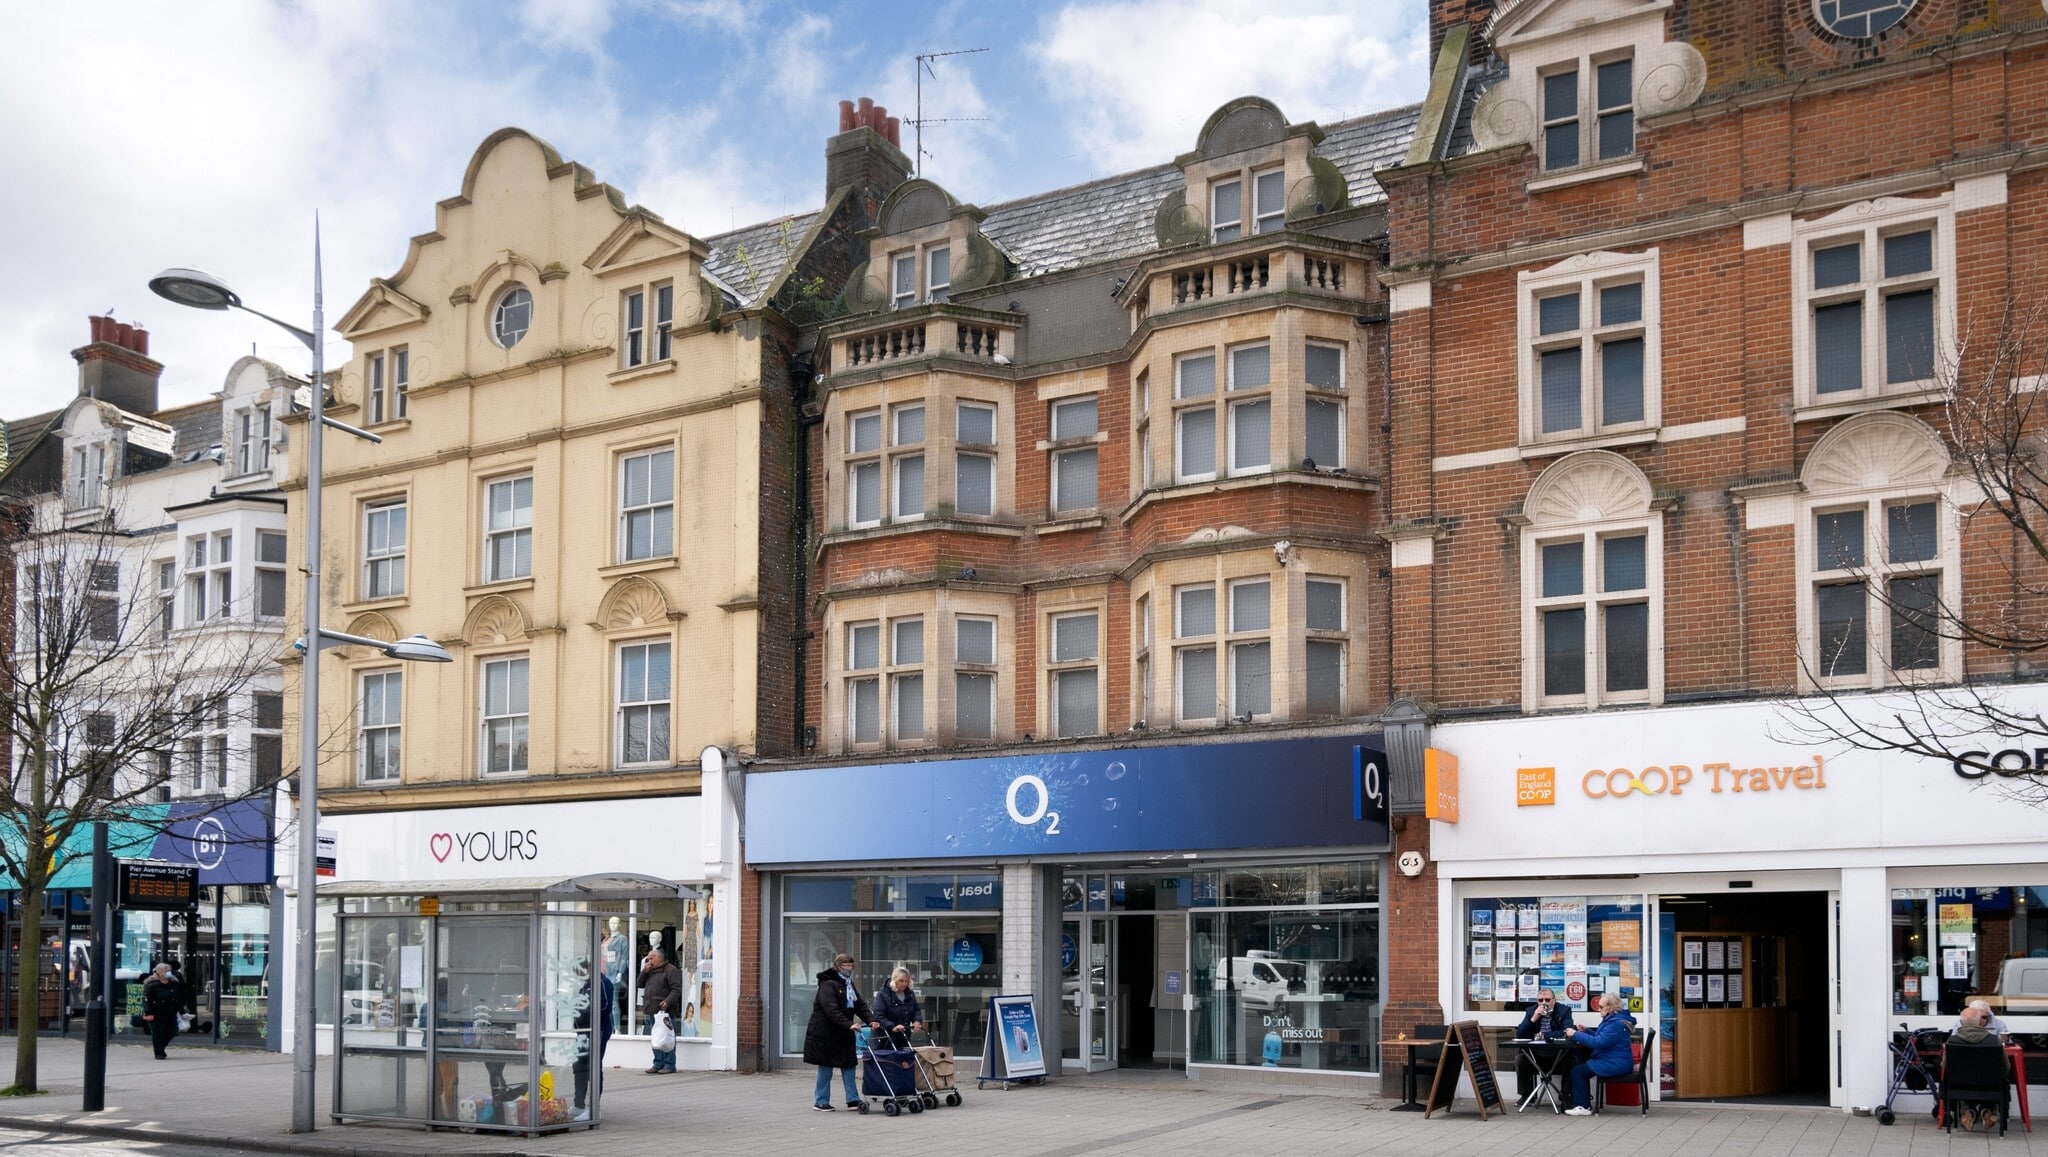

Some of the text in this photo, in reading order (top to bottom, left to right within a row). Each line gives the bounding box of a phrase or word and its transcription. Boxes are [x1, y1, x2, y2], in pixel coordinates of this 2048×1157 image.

[1537, 772, 1546, 780] of
[1582, 755, 1826, 799] COOP Travel
[1365, 763, 1383, 809] O2
[1520, 780, 1551, 790] England
[1520, 790, 1552, 800] COOP
[1006, 775, 1060, 835] O2
[200, 833, 219, 853] BT
[456, 829, 538, 862] YOURS
[186, 868, 193, 877] C
[1609, 923, 1632, 931] OPEN
[1263, 1015, 1291, 1028] Don't
[1282, 1027, 1323, 1038] miss out
